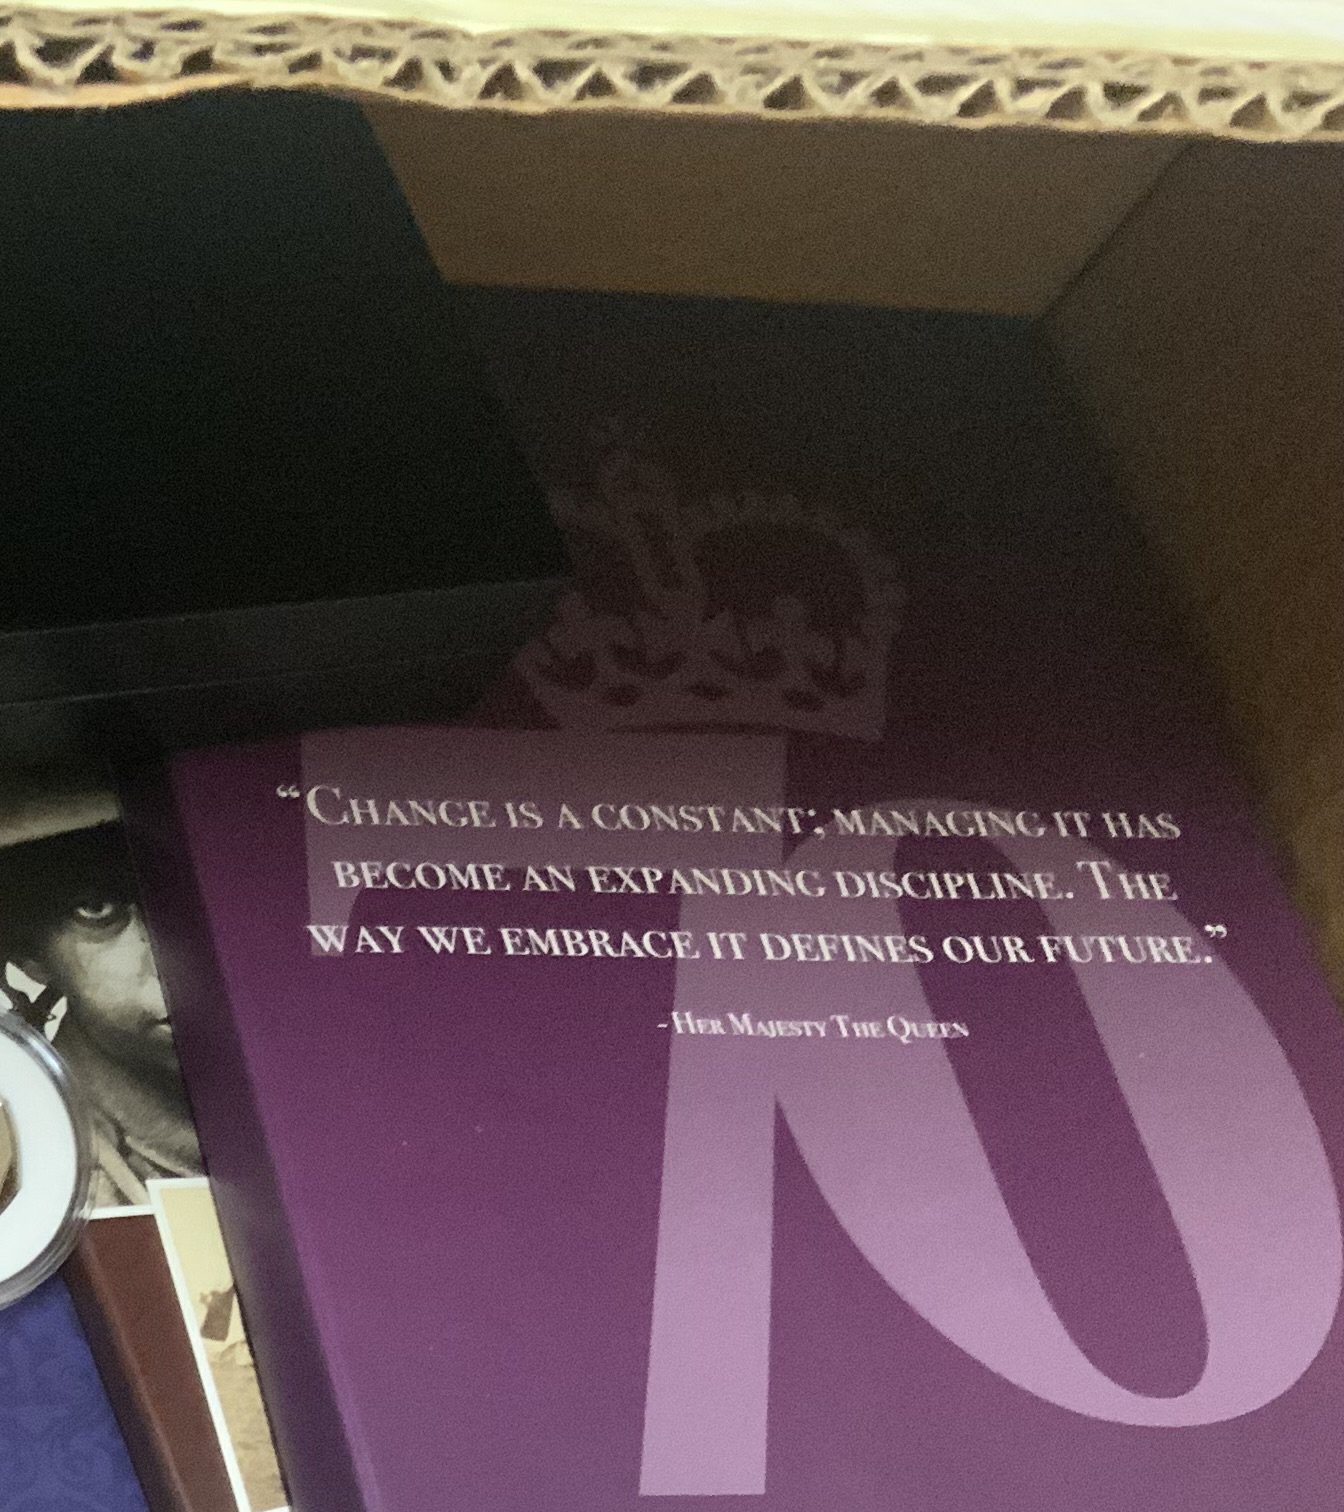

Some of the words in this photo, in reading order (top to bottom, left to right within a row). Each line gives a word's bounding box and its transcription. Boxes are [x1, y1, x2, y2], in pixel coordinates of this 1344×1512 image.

[507, 802, 544, 830] IS
[557, 803, 586, 831] A
[591, 803, 826, 841] CONSTANT;
[833, 808, 1048, 838] MANAGING
[1054, 811, 1092, 839] IT
[1102, 811, 1182, 840] HAS
[332, 860, 511, 892] BECOME
[522, 864, 576, 893] AN
[587, 866, 827, 898] EXPANDING
[833, 869, 1075, 900] DISCIPLINE.
[1076, 860, 1178, 901] THE
[306, 924, 405, 954] WAY
[417, 926, 492, 955] WE
[498, 927, 701, 960] EMBRACE
[706, 931, 747, 961] IT
[759, 931, 934, 963] DEFINES
[942, 935, 1035, 964] OUR
[727, 1012, 827, 1038] MAJESTY
[829, 1014, 885, 1038] THE
[886, 1014, 970, 1044] QUEEN
